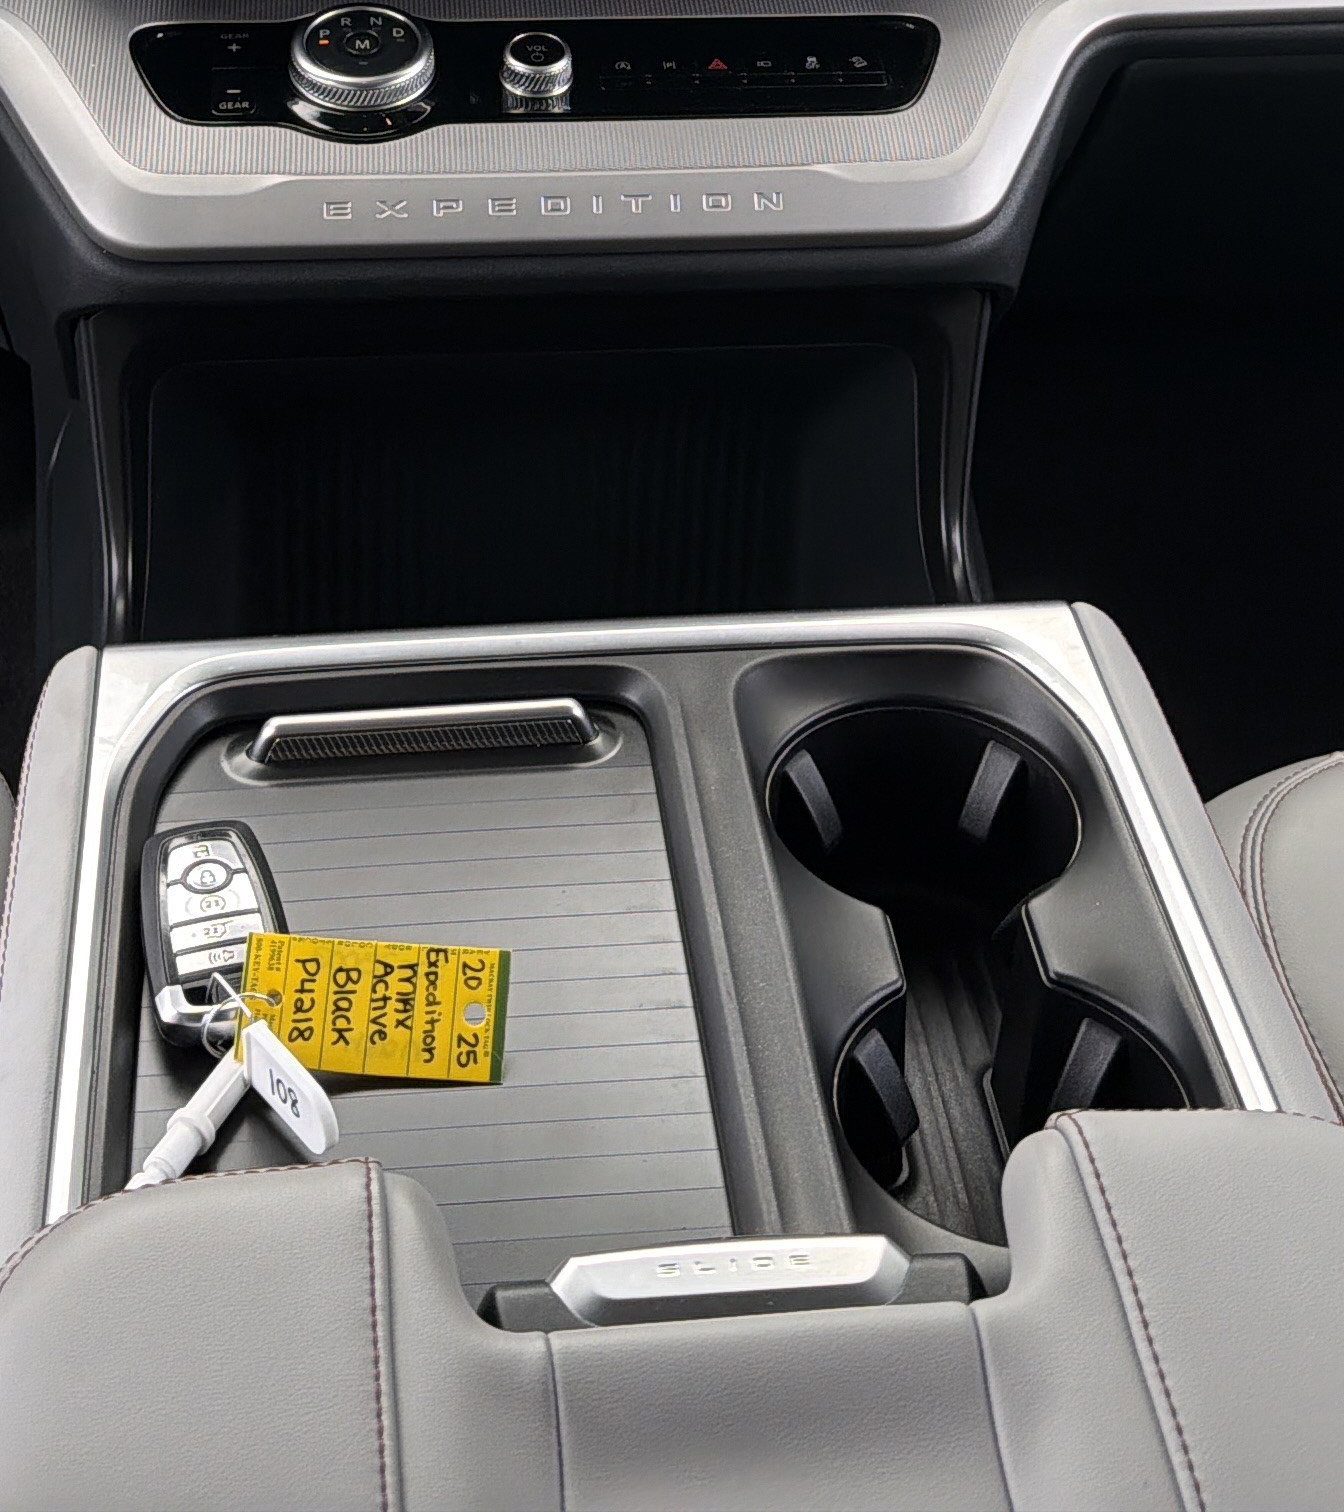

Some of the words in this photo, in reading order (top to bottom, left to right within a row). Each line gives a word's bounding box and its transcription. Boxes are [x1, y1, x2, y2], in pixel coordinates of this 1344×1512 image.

[319, 29, 330, 39] P
[341, 17, 353, 27] R
[370, 16, 383, 26] N
[392, 28, 405, 39] D
[355, 39, 371, 50] M
[526, 44, 548, 52] VOL
[219, 101, 249, 109] GEAR
[322, 191, 784, 220] EXPEDITION
[461, 958, 486, 991] 20
[287, 958, 321, 1042] P4218
[331, 965, 362, 1046] Black
[369, 958, 395, 1046] Active
[393, 961, 419, 1031] MAX
[421, 948, 449, 1064] Expedition
[456, 1032, 480, 1068] 25
[269, 1068, 301, 1119] 108
